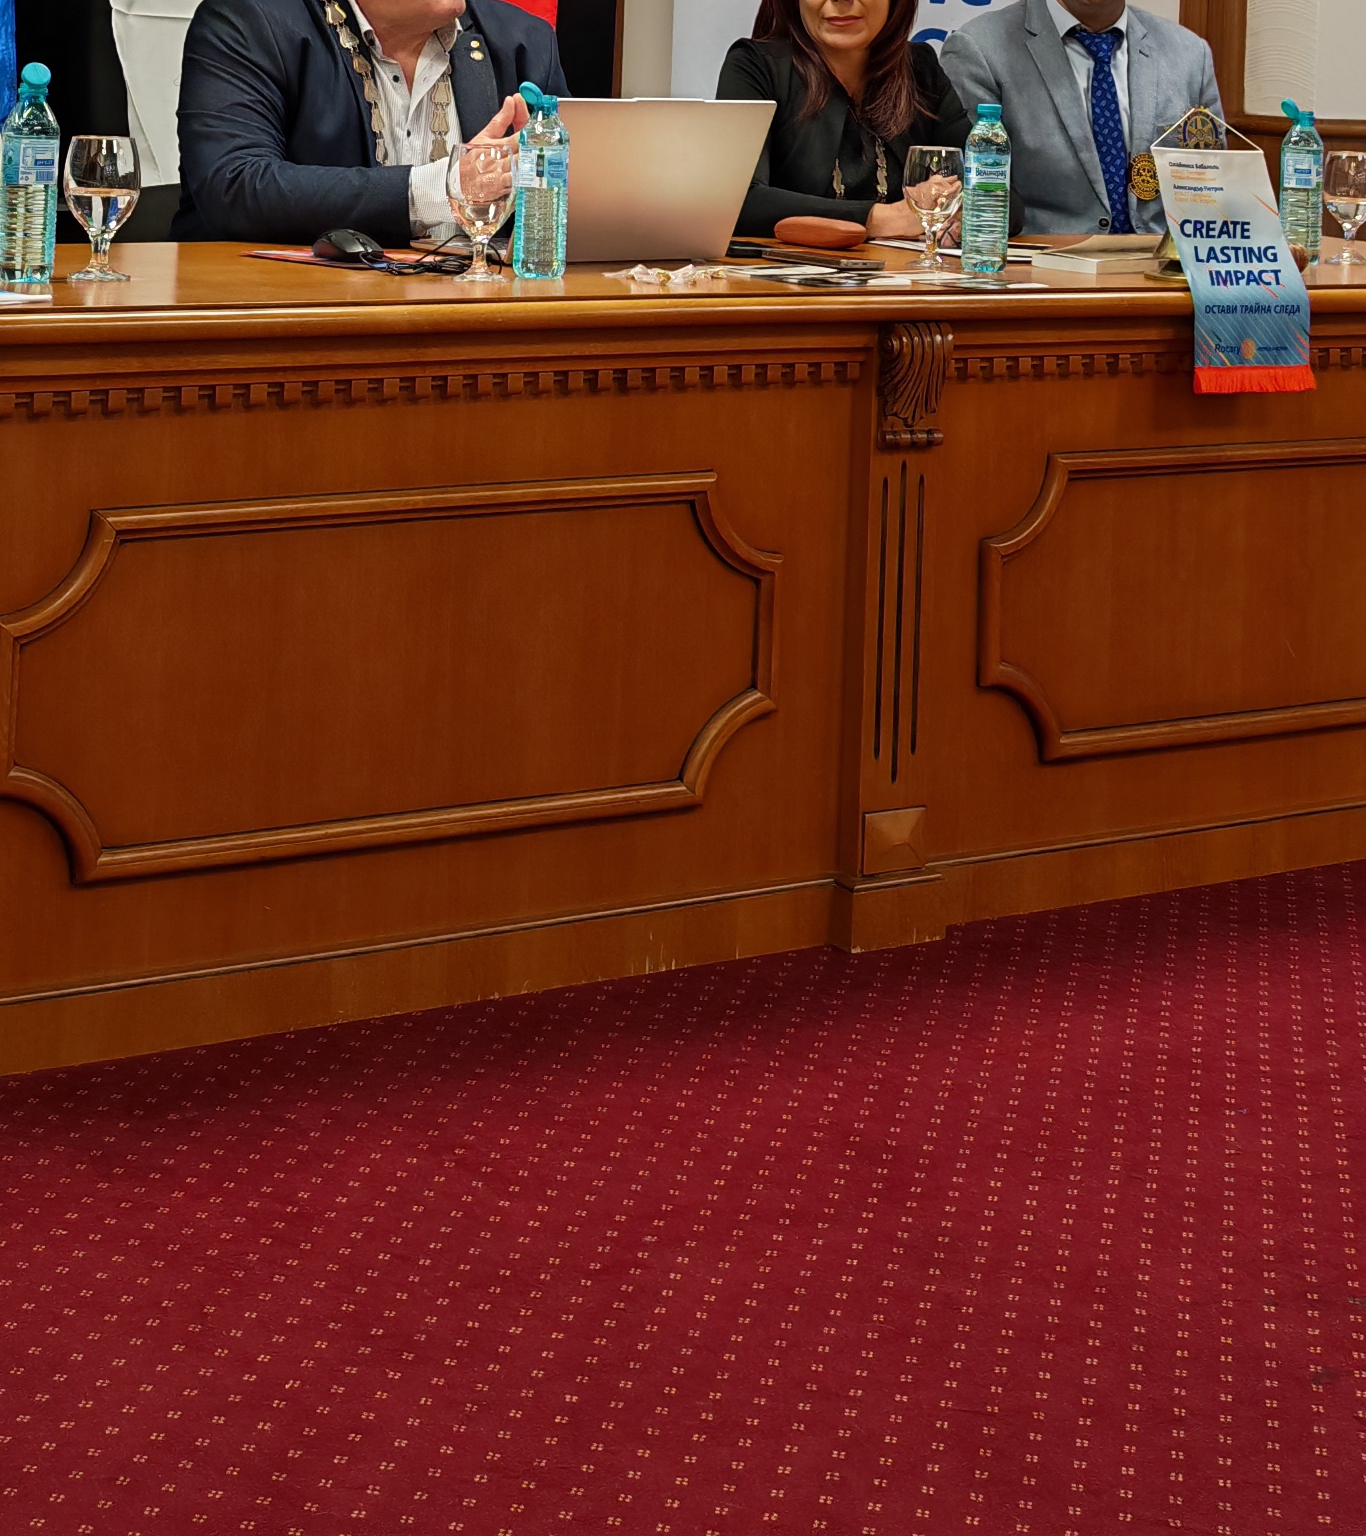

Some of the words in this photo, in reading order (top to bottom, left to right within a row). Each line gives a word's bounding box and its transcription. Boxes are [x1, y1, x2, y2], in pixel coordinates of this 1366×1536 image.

[1179, 218, 1251, 240] CREATE
[1193, 245, 1279, 264] LASTING
[1208, 269, 1282, 287] IMPACT
[1204, 304, 1238, 315] ОСТАВИ
[1240, 302, 1272, 315] ТРАЙНА
[1214, 343, 1241, 356] Rotary
